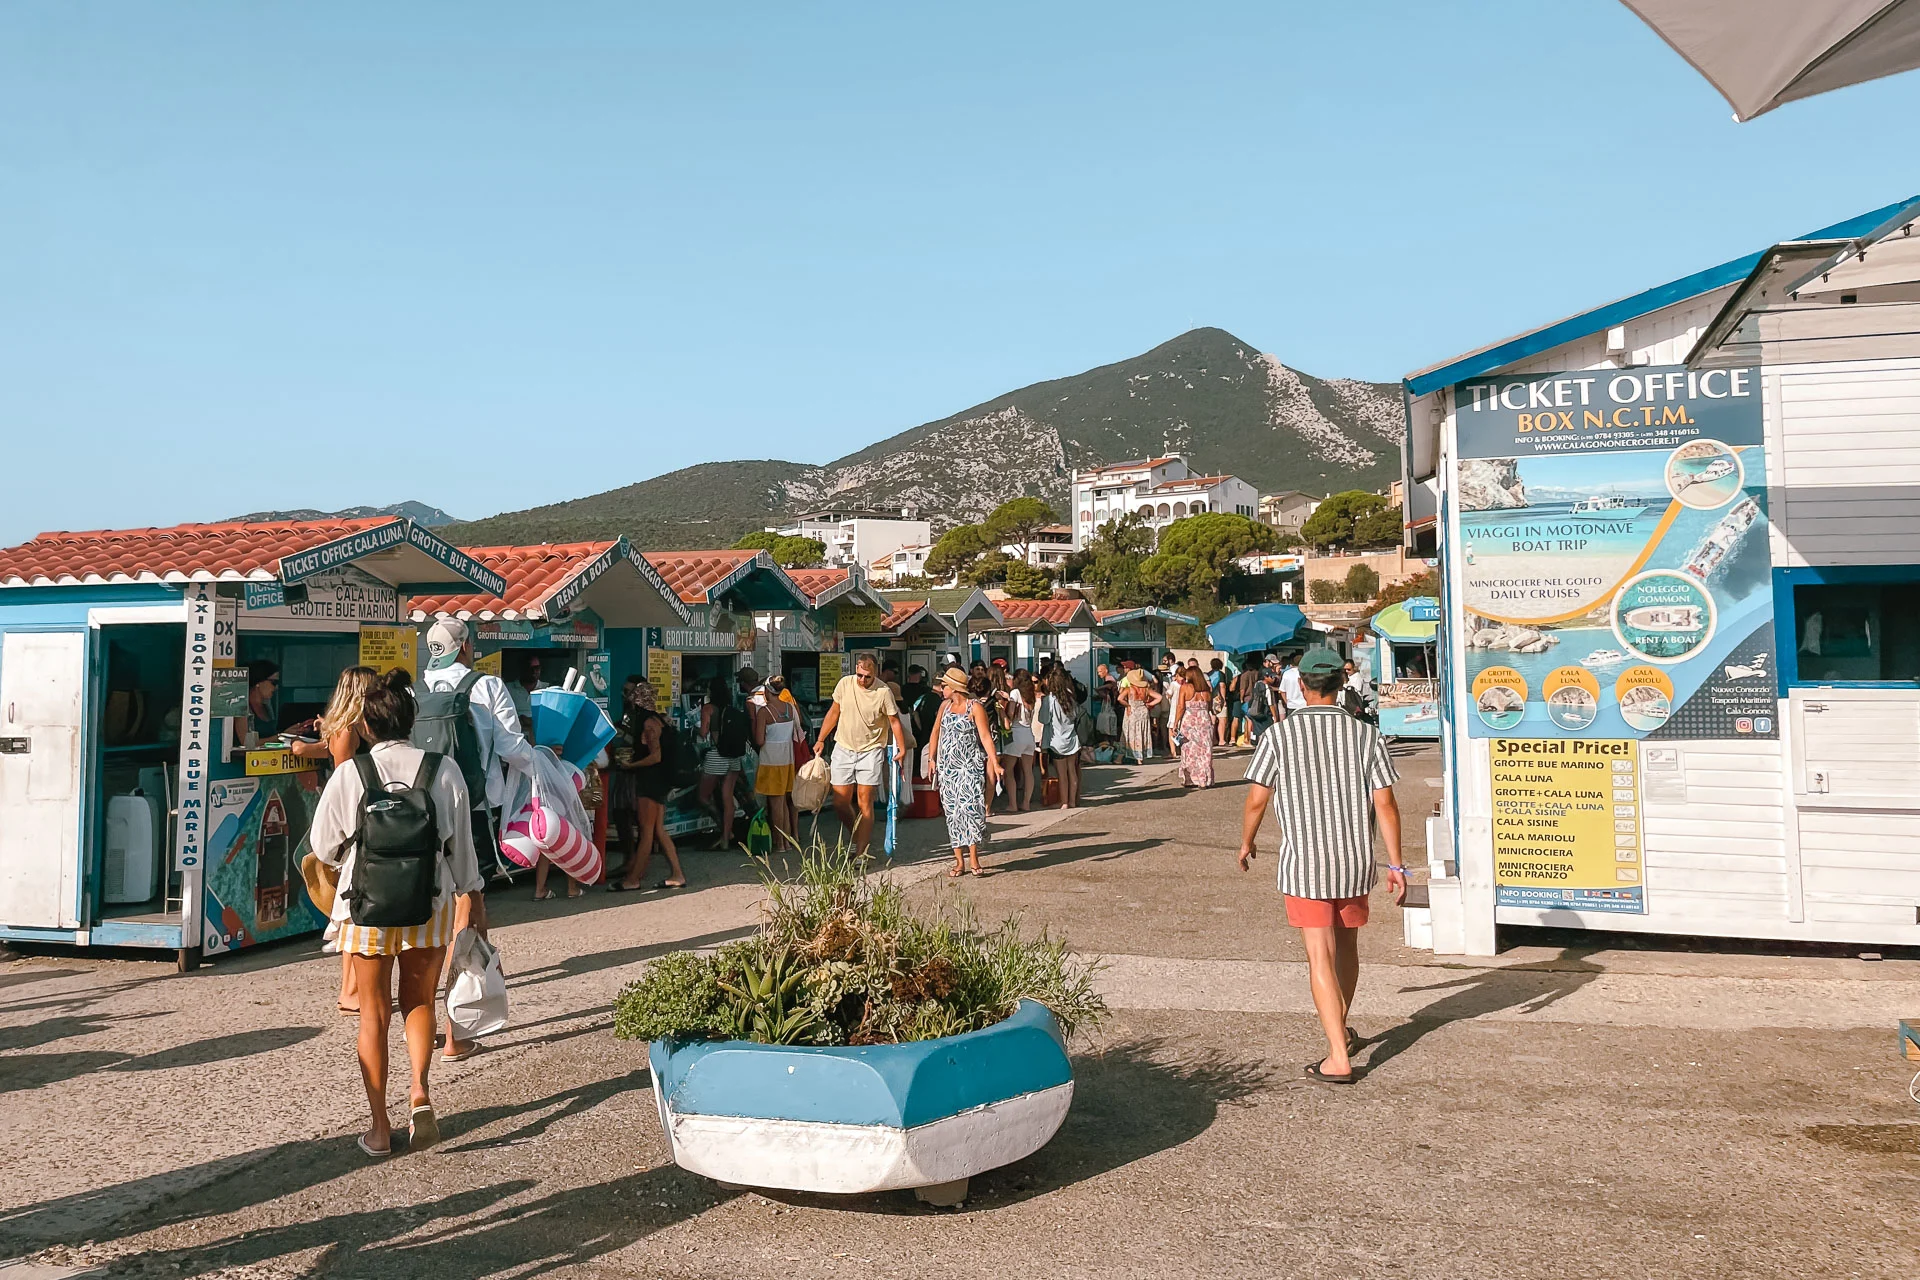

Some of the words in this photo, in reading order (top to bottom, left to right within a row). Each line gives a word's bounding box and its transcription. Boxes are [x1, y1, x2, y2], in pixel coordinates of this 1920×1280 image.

[1466, 378, 1595, 412] TICKET
[1608, 368, 1750, 404] OFFICE
[1518, 411, 1575, 433] BOX
[1583, 404, 1695, 430] N.C.T.M.
[1514, 436, 1533, 444] INFO
[1541, 433, 1580, 443] BOOKING:
[1594, 432, 1613, 440] 0784
[1654, 429, 1668, 437] 348
[1535, 437, 1680, 451] WWW.CALAGONONECROCIERE.IT
[1467, 526, 1519, 538] VIAGGI
[1526, 525, 1541, 537] IN
[1546, 523, 1633, 536] MOTONAVE
[284, 553, 319, 577] TICKET
[321, 542, 354, 565] OFFICE
[354, 534, 379, 553] CALA
[379, 526, 404, 545] LUNA
[1512, 540, 1551, 552] BOAT
[1556, 539, 1587, 551] TRIP
[411, 528, 447, 559] GROTTE
[449, 551, 468, 572] BUE
[469, 564, 503, 593] MARINO
[556, 580, 579, 609] RENT
[581, 575, 589, 589] A
[589, 552, 612, 581] BOAT
[628, 547, 661, 589] NOLEGGIO
[660, 584, 692, 624] GOMMONI
[1469, 578, 1541, 588] MINICROCIERE
[1544, 577, 1563, 587] NEL
[1566, 577, 1602, 586] GOLFO
[336, 586, 364, 602] CALA
[367, 588, 395, 604] LUNA
[1490, 589, 1527, 600] DAILY
[1530, 588, 1580, 599] CRUISES
[1637, 585, 1690, 593] NOLEGGIO
[194, 582, 209, 625] TAXI
[250, 592, 284, 607] OFFICE
[1637, 595, 1690, 603] GOMMONI
[290, 601, 332, 617] GROTTE
[336, 602, 356, 618] BUE
[358, 604, 395, 619] MARINO
[1423, 608, 1441, 617] TIC
[689, 611, 706, 628] UNA
[214, 621, 234, 636] OX
[477, 631, 497, 640] GROTTE
[666, 630, 693, 647] GROTTE
[695, 631, 708, 647] BUE
[709, 632, 735, 648] MARINO
[1635, 636, 1660, 644] RENT
[1661, 636, 1669, 644] A
[1670, 636, 1697, 644] BOAT
[191, 633, 207, 676] BOAT
[219, 641, 233, 656] 16
[228, 670, 248, 678] BOAT
[1711, 696, 1739, 705] Trasporti
[1740, 696, 1771, 704] Marittimi
[187, 684, 205, 751] GROTTA
[1725, 707, 1741, 715] Cala
[1742, 707, 1771, 715] Gonone
[1497, 740, 1565, 756] Special
[1573, 741, 1629, 755] Price!
[1494, 759, 1534, 768] GROTTE
[1537, 760, 1557, 769] BUE
[1560, 761, 1605, 770] MARINO
[186, 759, 200, 791] BUE
[1494, 774, 1522, 782] CALA
[1525, 774, 1553, 783] LUNA
[1575, 790, 1604, 799] LUNA
[1535, 809, 1567, 817] SISINE
[1576, 803, 1605, 811] LUNA
[1496, 818, 1524, 826] CALA
[1527, 819, 1559, 828] SISINE
[182, 799, 201, 866] MARINO
[1497, 832, 1525, 841] CALA
[1527, 833, 1575, 843] MARIOLU
[1497, 847, 1574, 857] MINICROCIERA
[1498, 862, 1574, 872] MINICROCIERA
[1499, 870, 1522, 878] CON
[1524, 871, 1568, 879] PRANZO
[1521, 890, 1561, 898] BOOKING:
